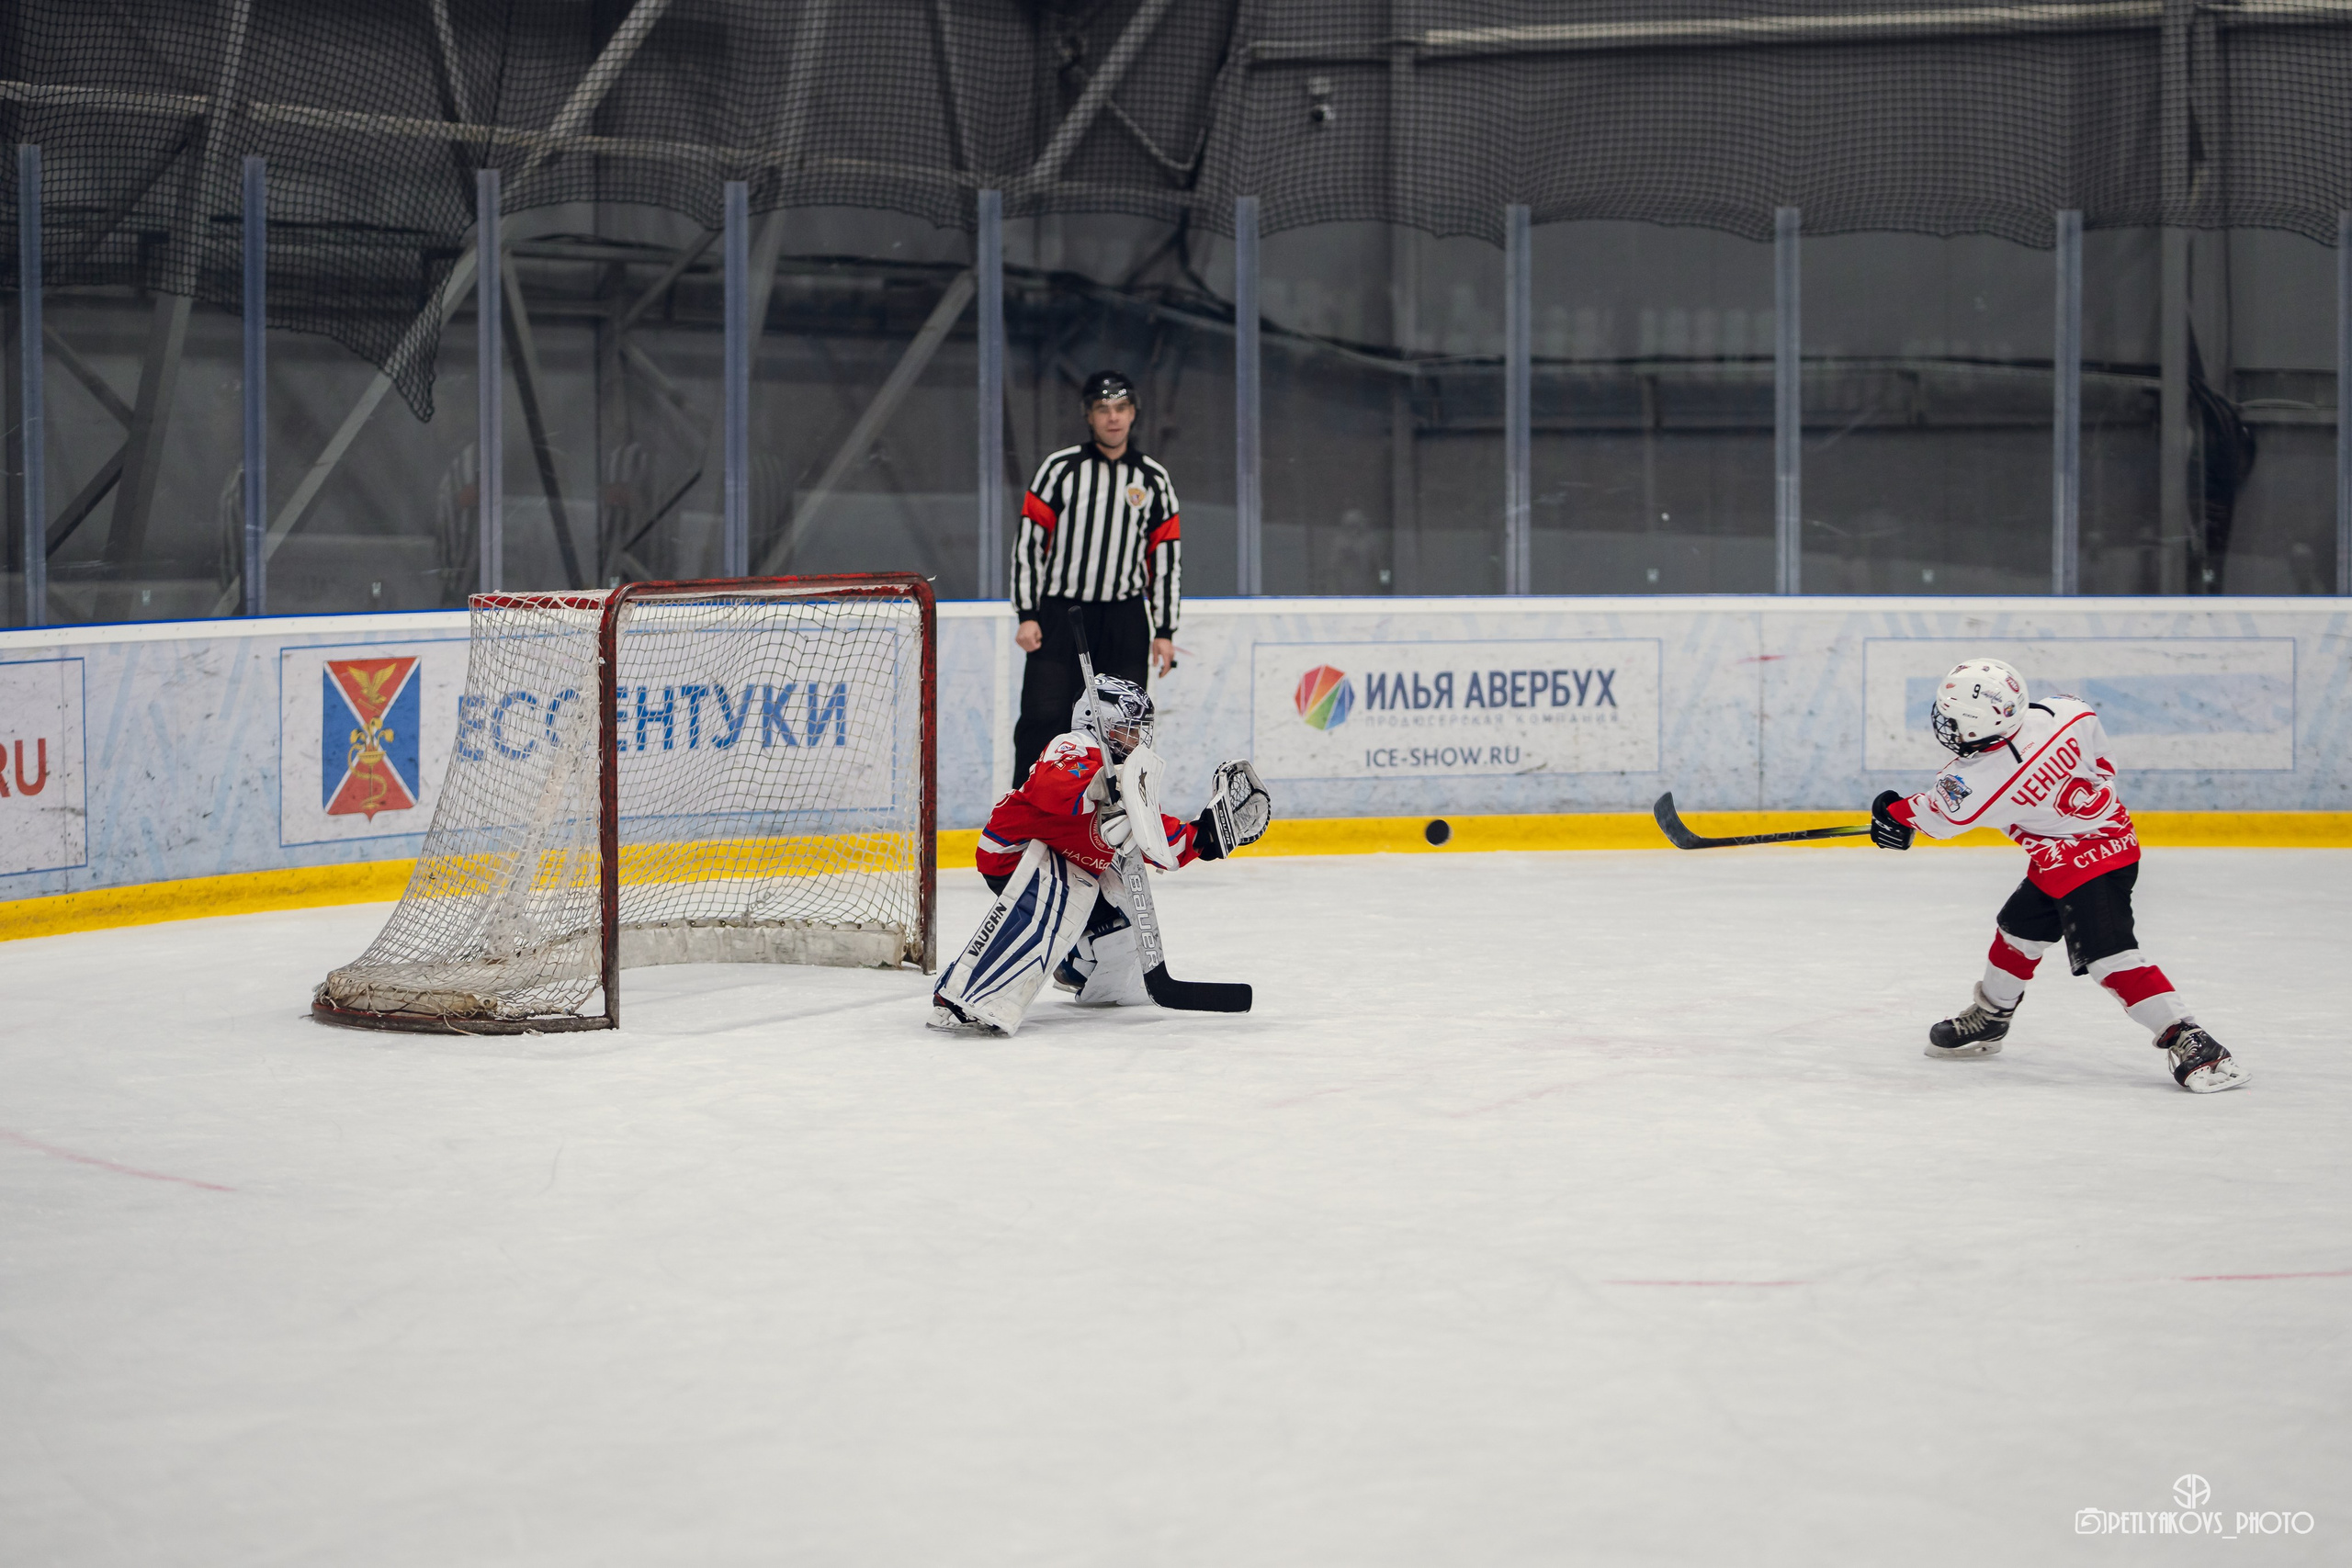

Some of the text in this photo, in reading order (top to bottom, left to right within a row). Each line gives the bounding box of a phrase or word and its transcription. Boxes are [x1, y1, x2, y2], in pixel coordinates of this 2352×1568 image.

[1365, 668, 1618, 710] ИЛЬЯ АВЕРБУХ
[1972, 683, 1982, 699] 9
[1365, 711, 1620, 728] ПРОДЮСЕРСКАЯ КОМПАНИЯ
[1365, 746, 1521, 768] ICE-SHOW.RU
[1733, 829, 1811, 845] VAPOR
[967, 902, 1008, 957] VAUGHN
